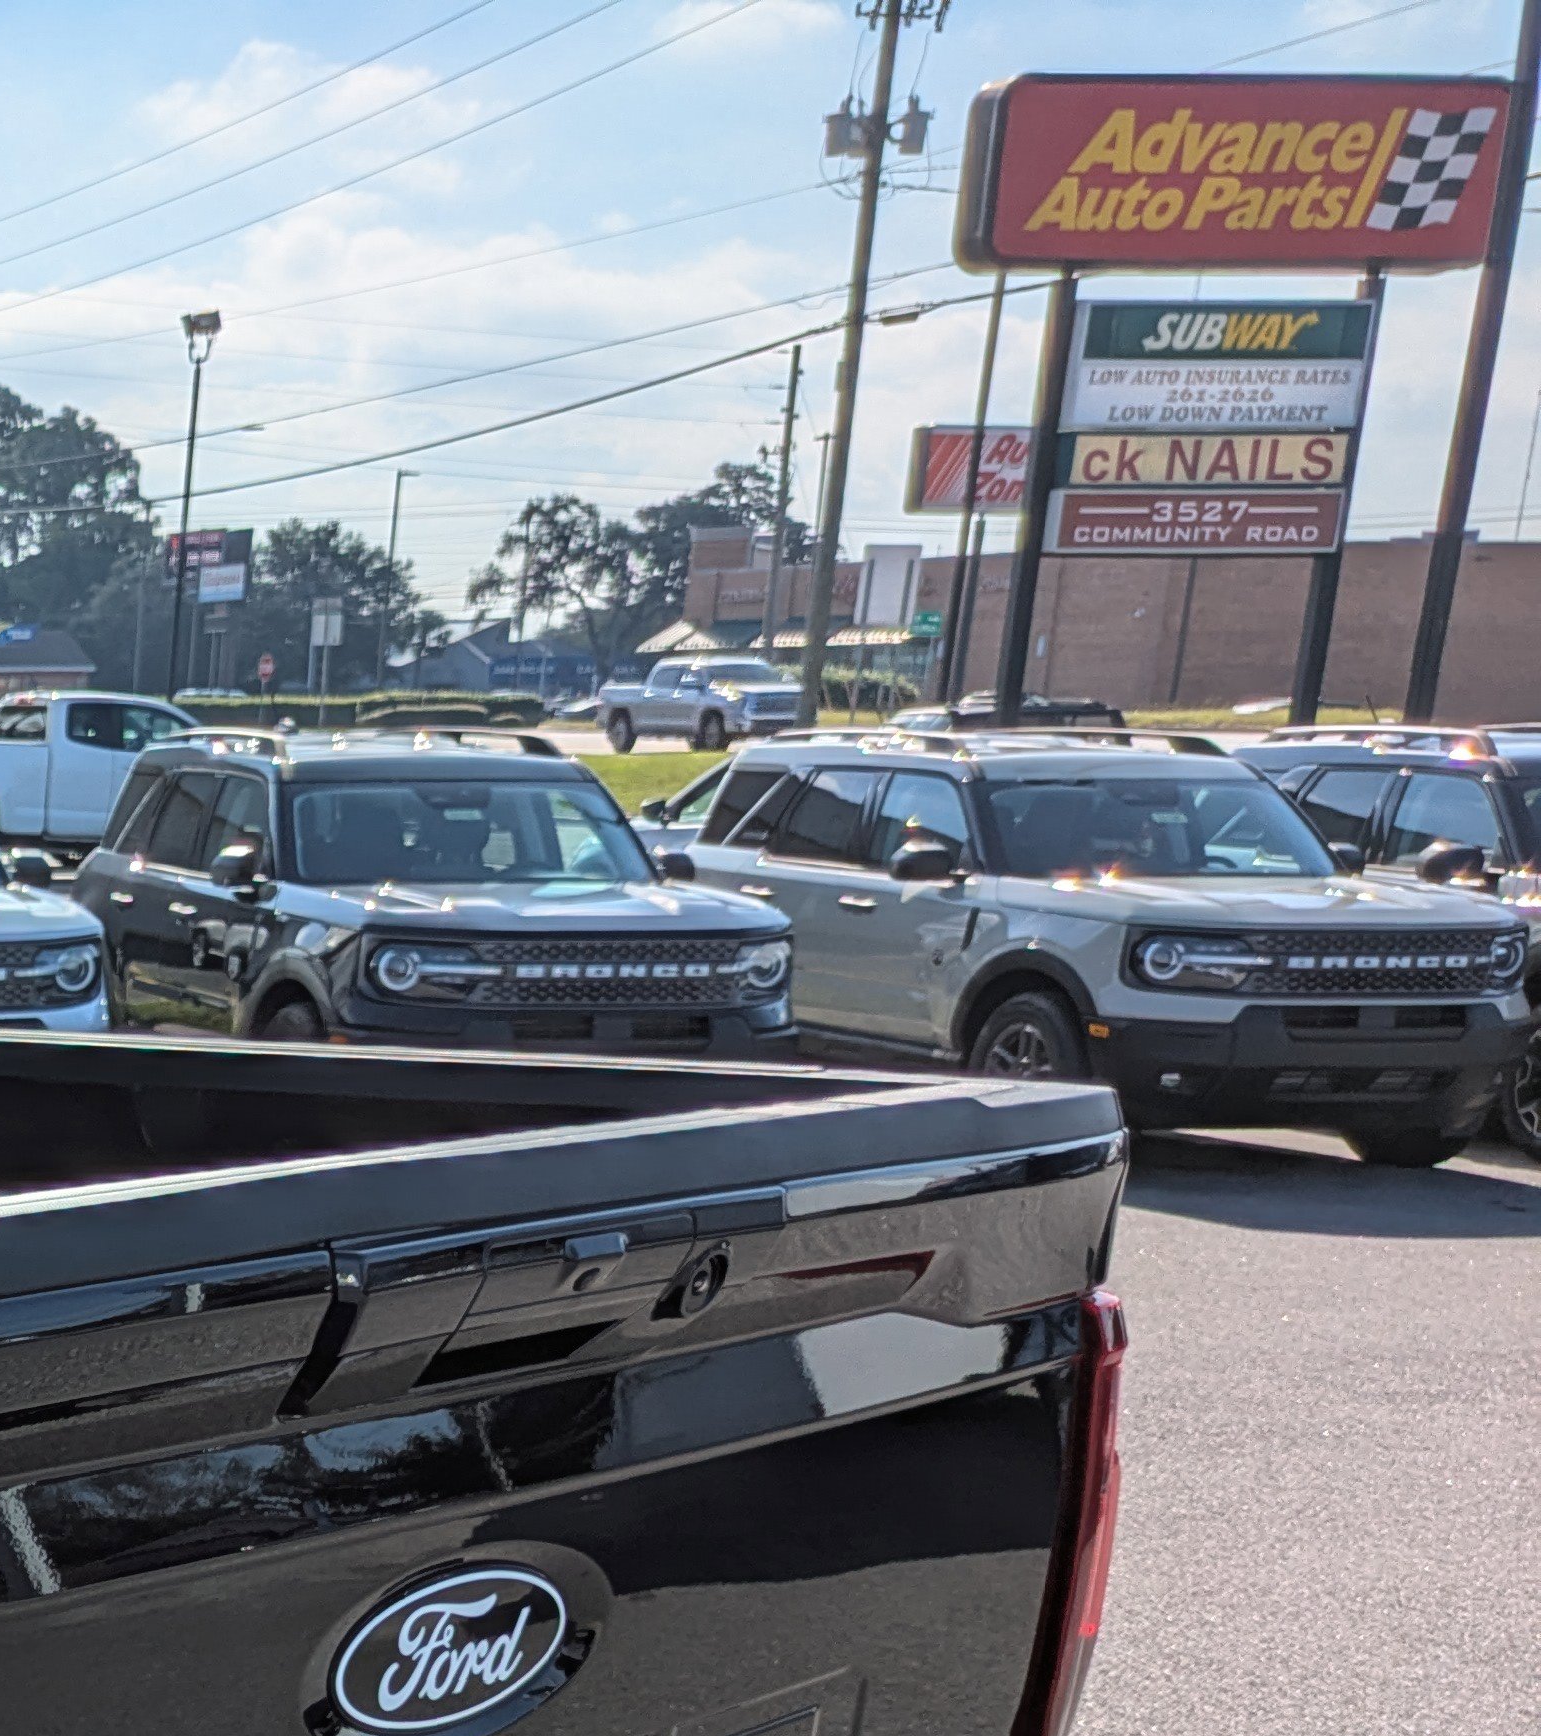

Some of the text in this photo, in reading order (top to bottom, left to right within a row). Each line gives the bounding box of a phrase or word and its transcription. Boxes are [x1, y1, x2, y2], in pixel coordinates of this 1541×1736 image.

[1067, 106, 1376, 174] Advance
[1024, 174, 1354, 232] Auto Parts
[1141, 310, 1320, 352] SUBWAY
[1088, 368, 1352, 386] LOW AUTO INSURANCE RATES
[1107, 405, 1330, 423] LOW DOWN PAYMENT
[1164, 437, 1335, 482] NAILS
[974, 470, 1026, 502] Zon
[1150, 500, 1250, 524] 3527
[1072, 525, 1320, 545] COMMUNITY ROAD
[515, 963, 711, 979] BRONCO
[1287, 955, 1469, 970] BRONCO
[377, 1592, 532, 1712] Ford
